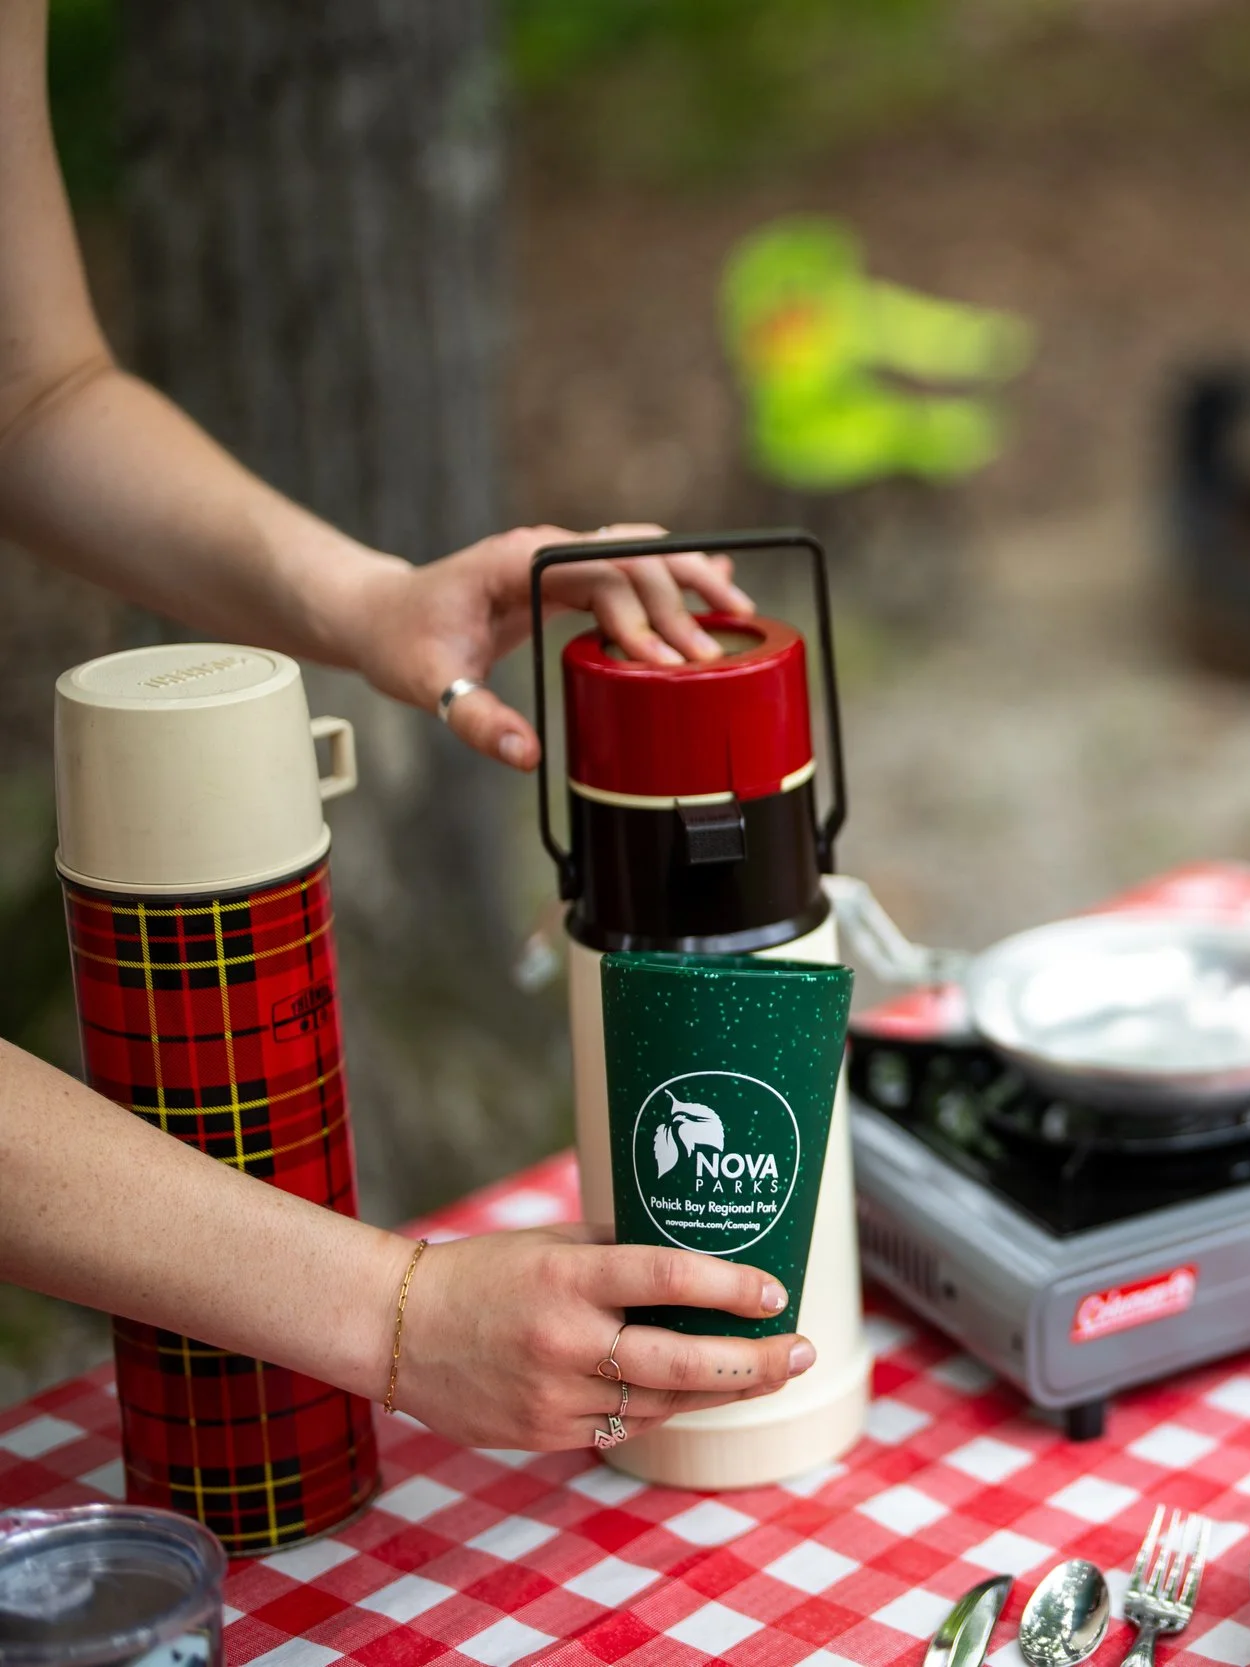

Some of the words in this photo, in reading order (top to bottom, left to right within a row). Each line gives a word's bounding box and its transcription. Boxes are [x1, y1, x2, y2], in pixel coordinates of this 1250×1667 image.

[696, 1152, 779, 1179] NOVA
[695, 1179, 779, 1194] PARKS
[650, 1196, 682, 1211] Pohick
[685, 1200, 706, 1215] Bay
[708, 1201, 754, 1217] Regional
[756, 1200, 778, 1214] Park
[665, 1219, 761, 1231] novaparks.com/Camping
